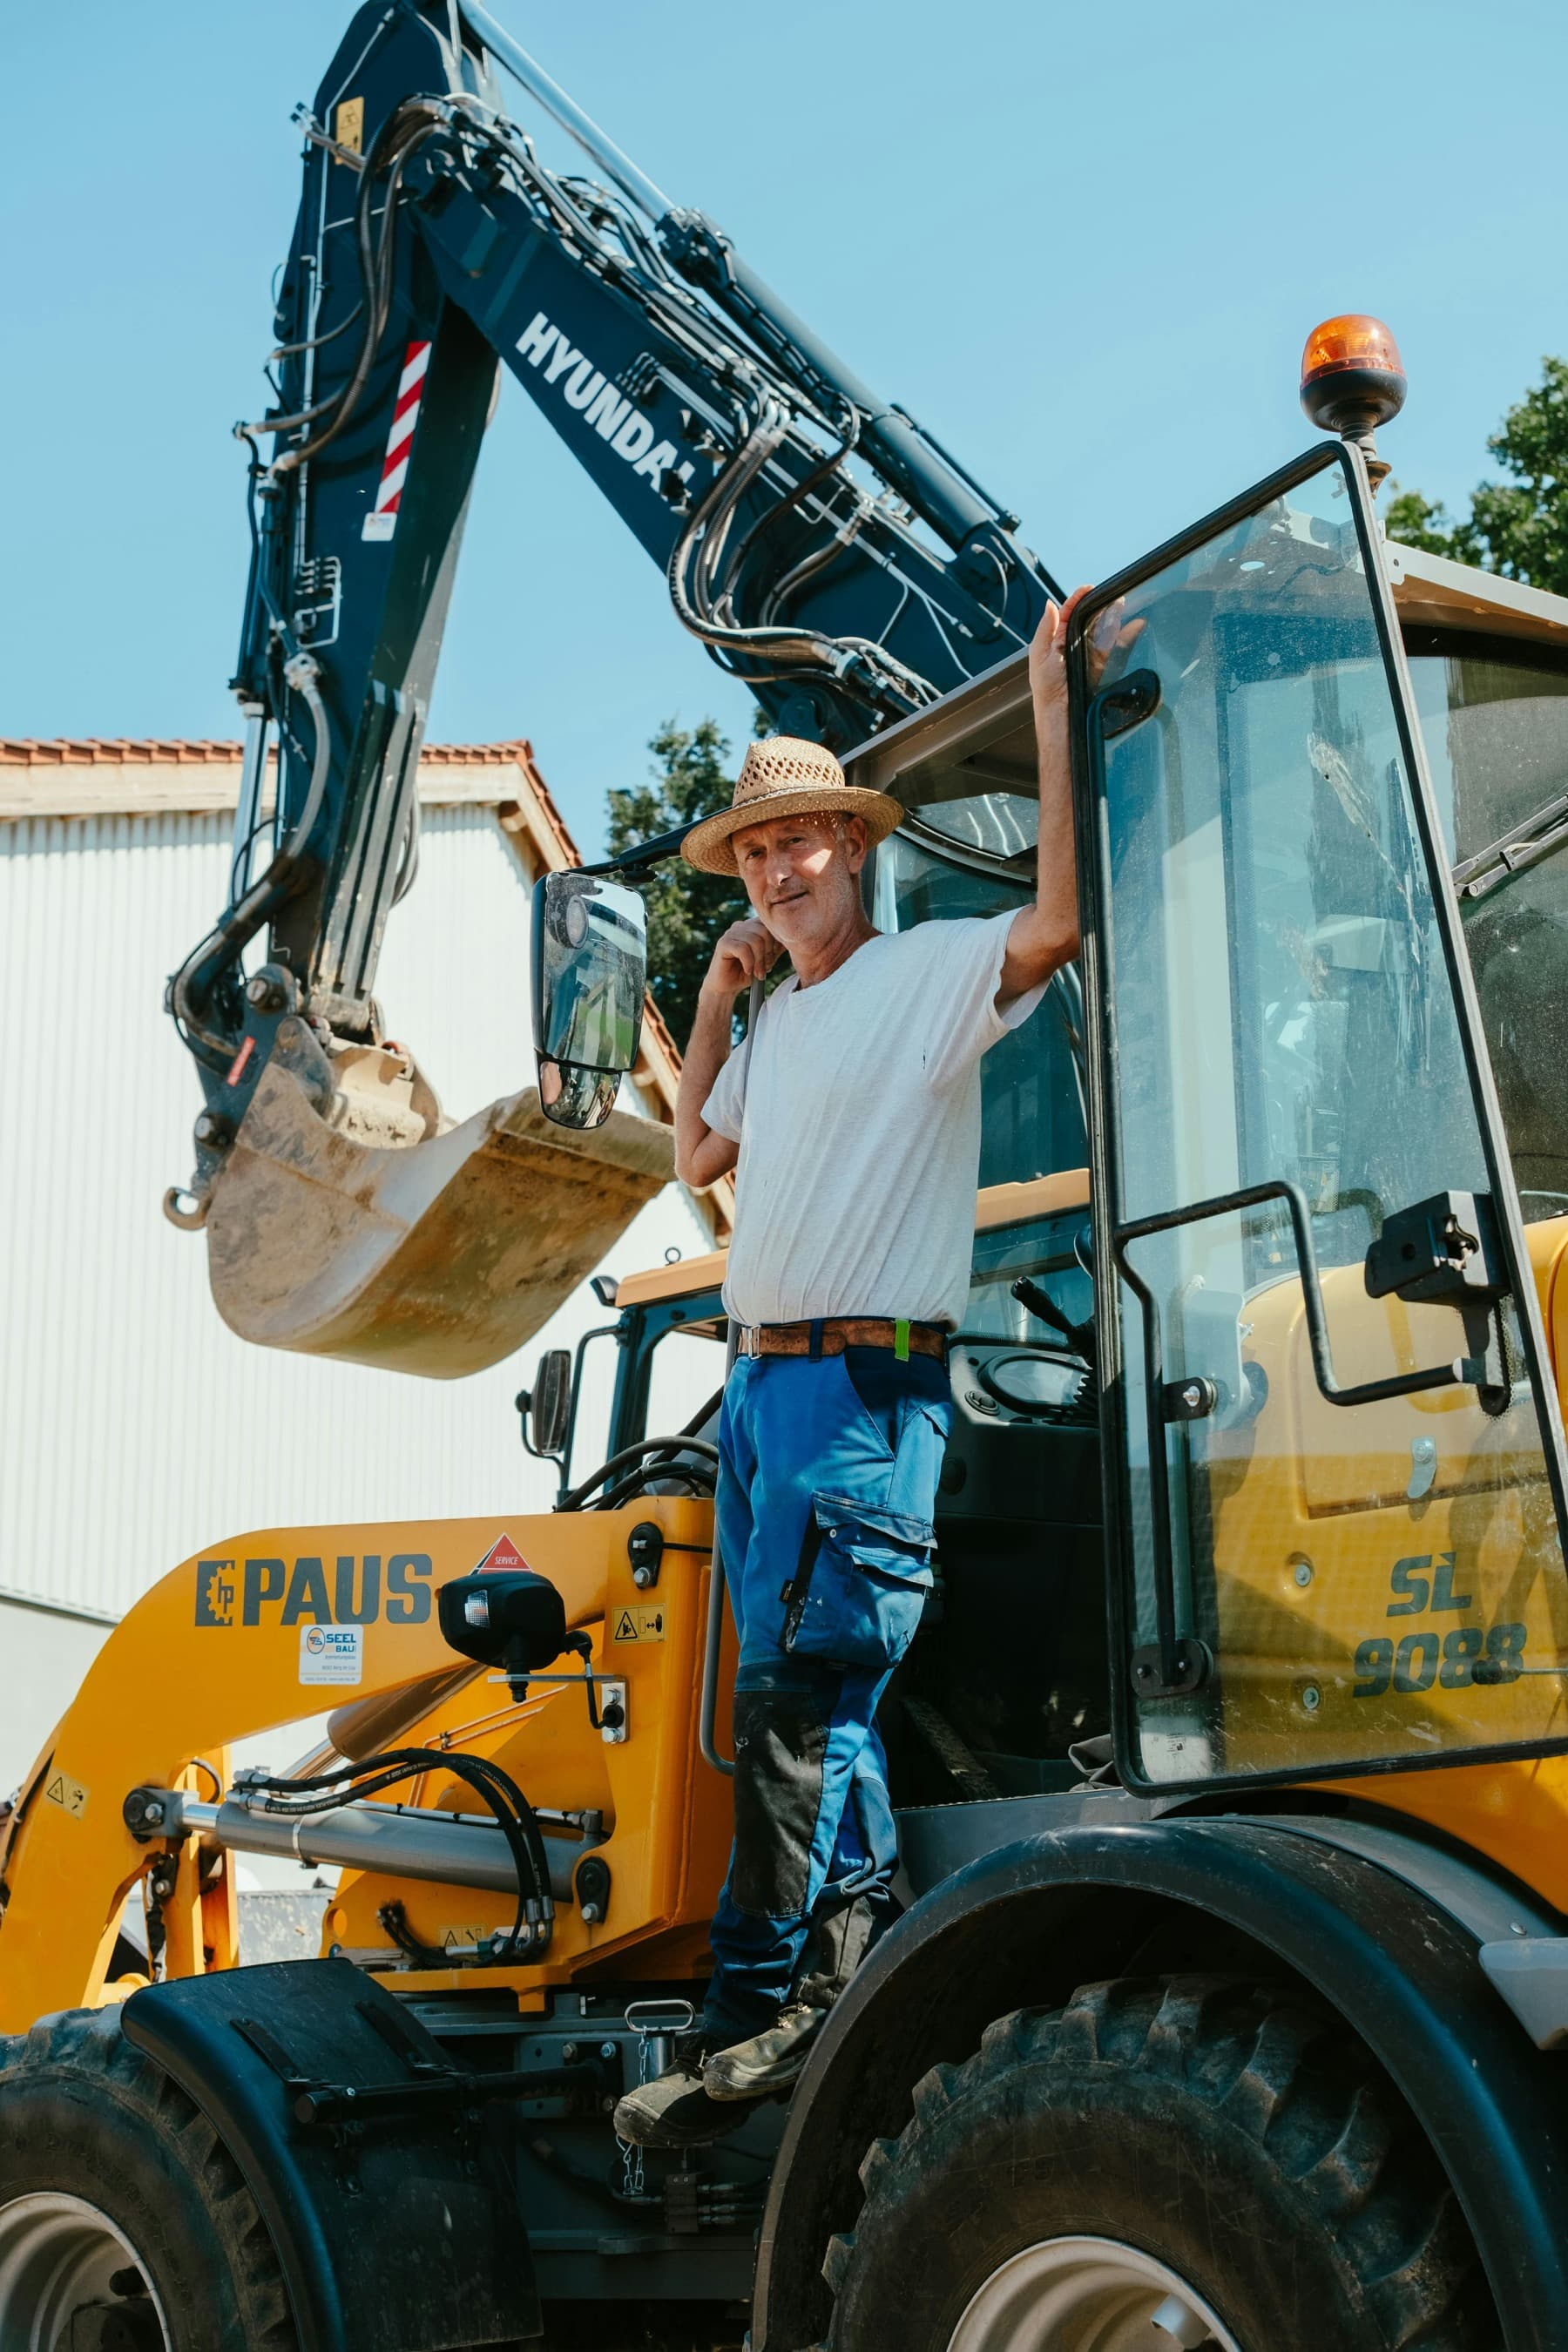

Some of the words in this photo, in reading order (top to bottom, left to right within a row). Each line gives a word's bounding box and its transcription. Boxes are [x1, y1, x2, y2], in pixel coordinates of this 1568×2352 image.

[242, 1553, 433, 1626] PAUS
[494, 1556, 519, 1565] SERVICE
[1386, 1551, 1472, 1618] SL
[326, 1633, 356, 1644] SEEL
[1352, 1623, 1527, 1698] 9088
